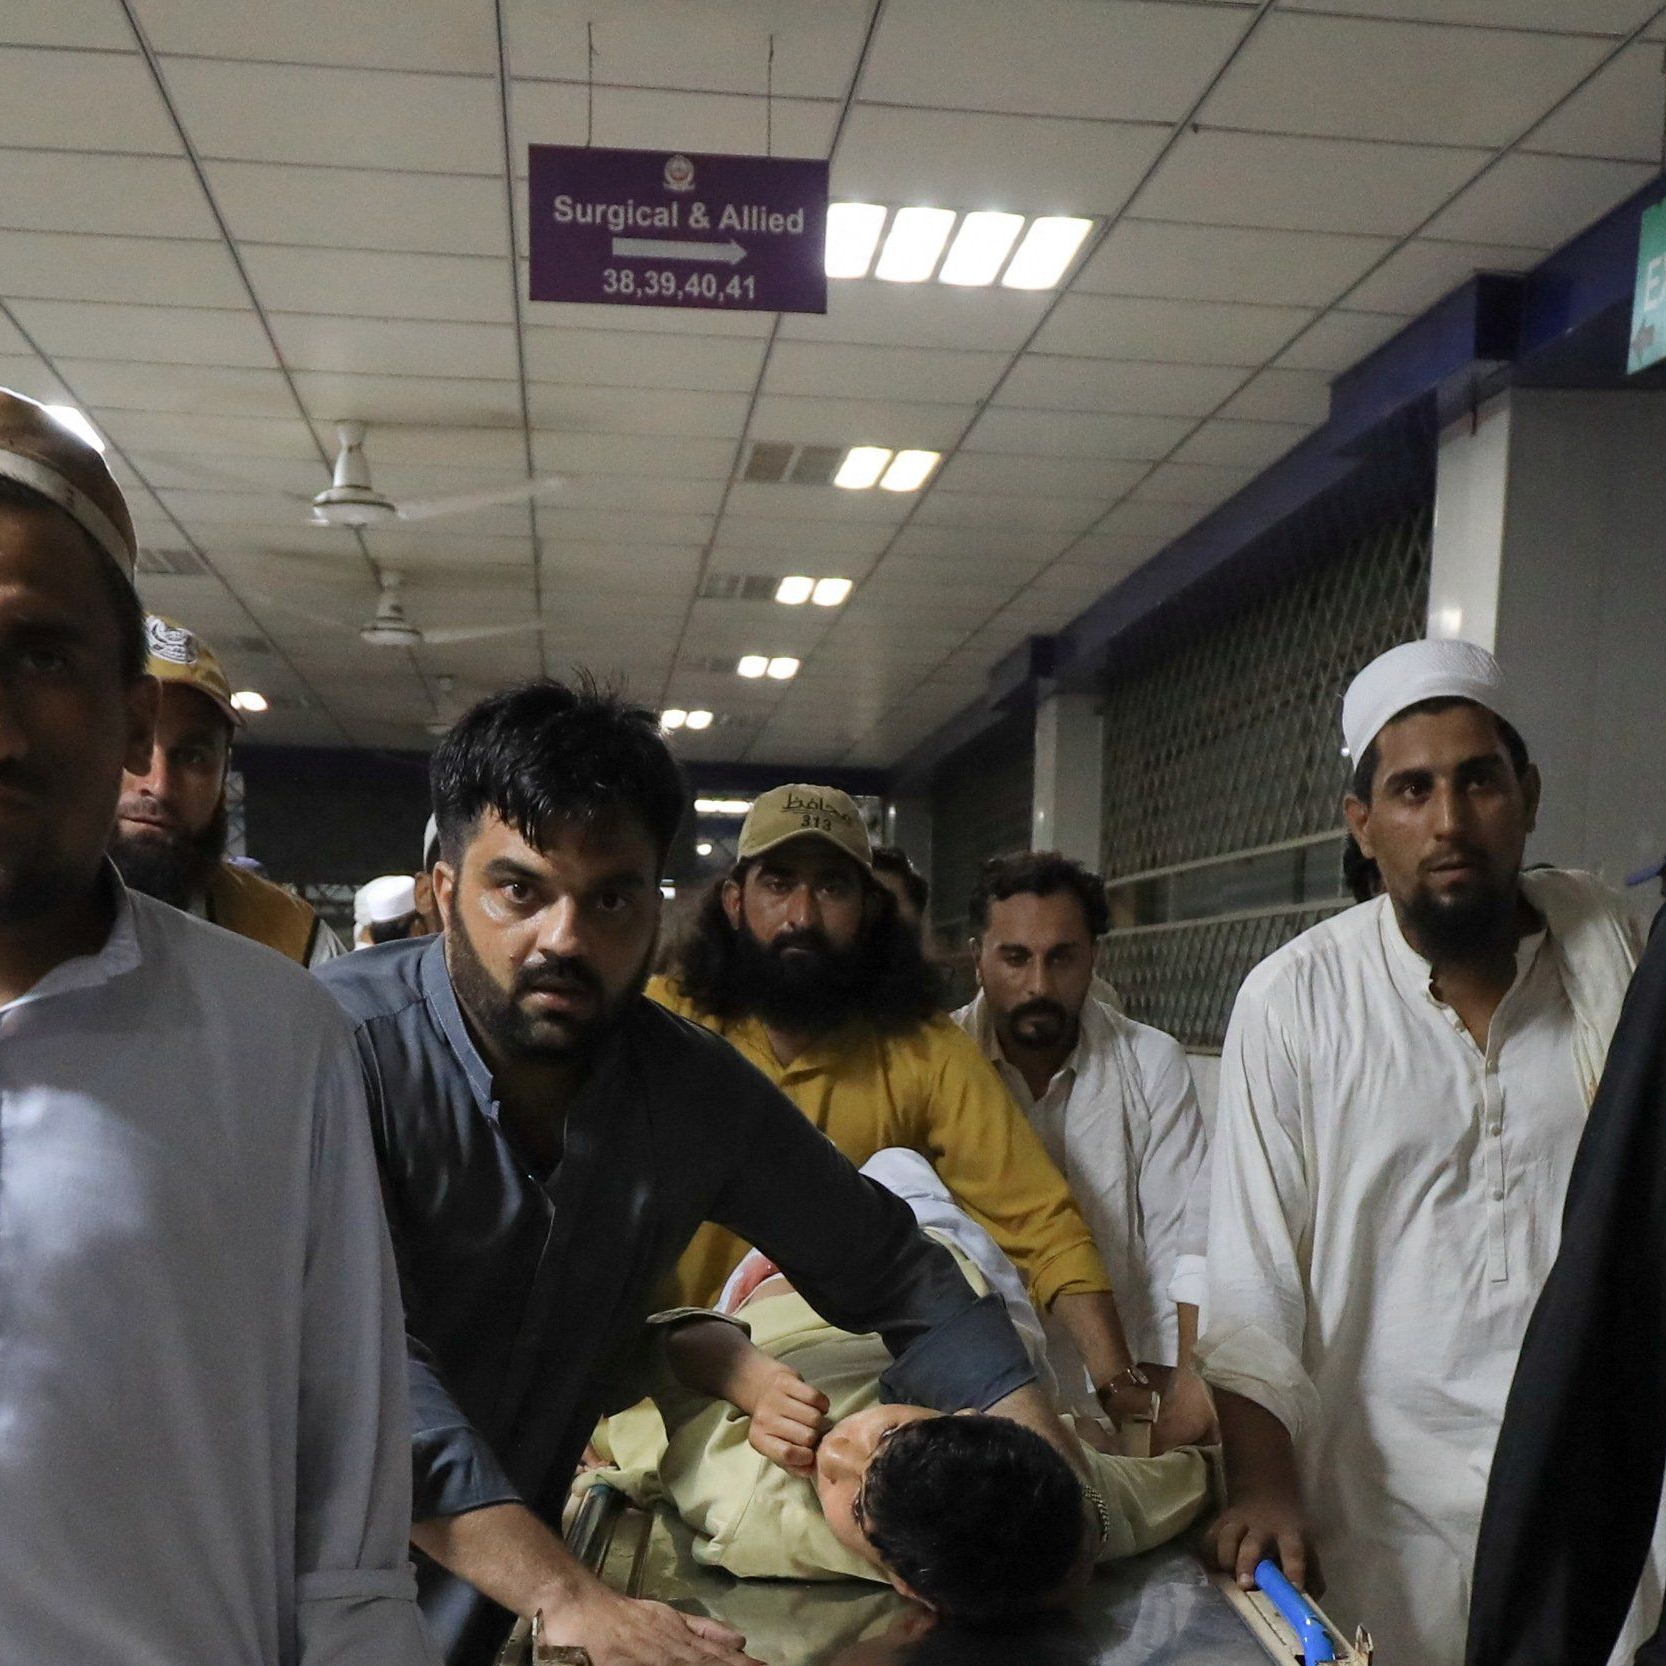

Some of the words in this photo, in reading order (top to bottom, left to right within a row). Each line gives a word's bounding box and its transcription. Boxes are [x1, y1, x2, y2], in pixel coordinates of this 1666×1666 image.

[553, 195, 679, 232] Surgical
[688, 202, 711, 230] &
[718, 204, 805, 234] Allied
[602, 268, 756, 302] 38,39,40,41
[801, 814, 832, 831] 313
